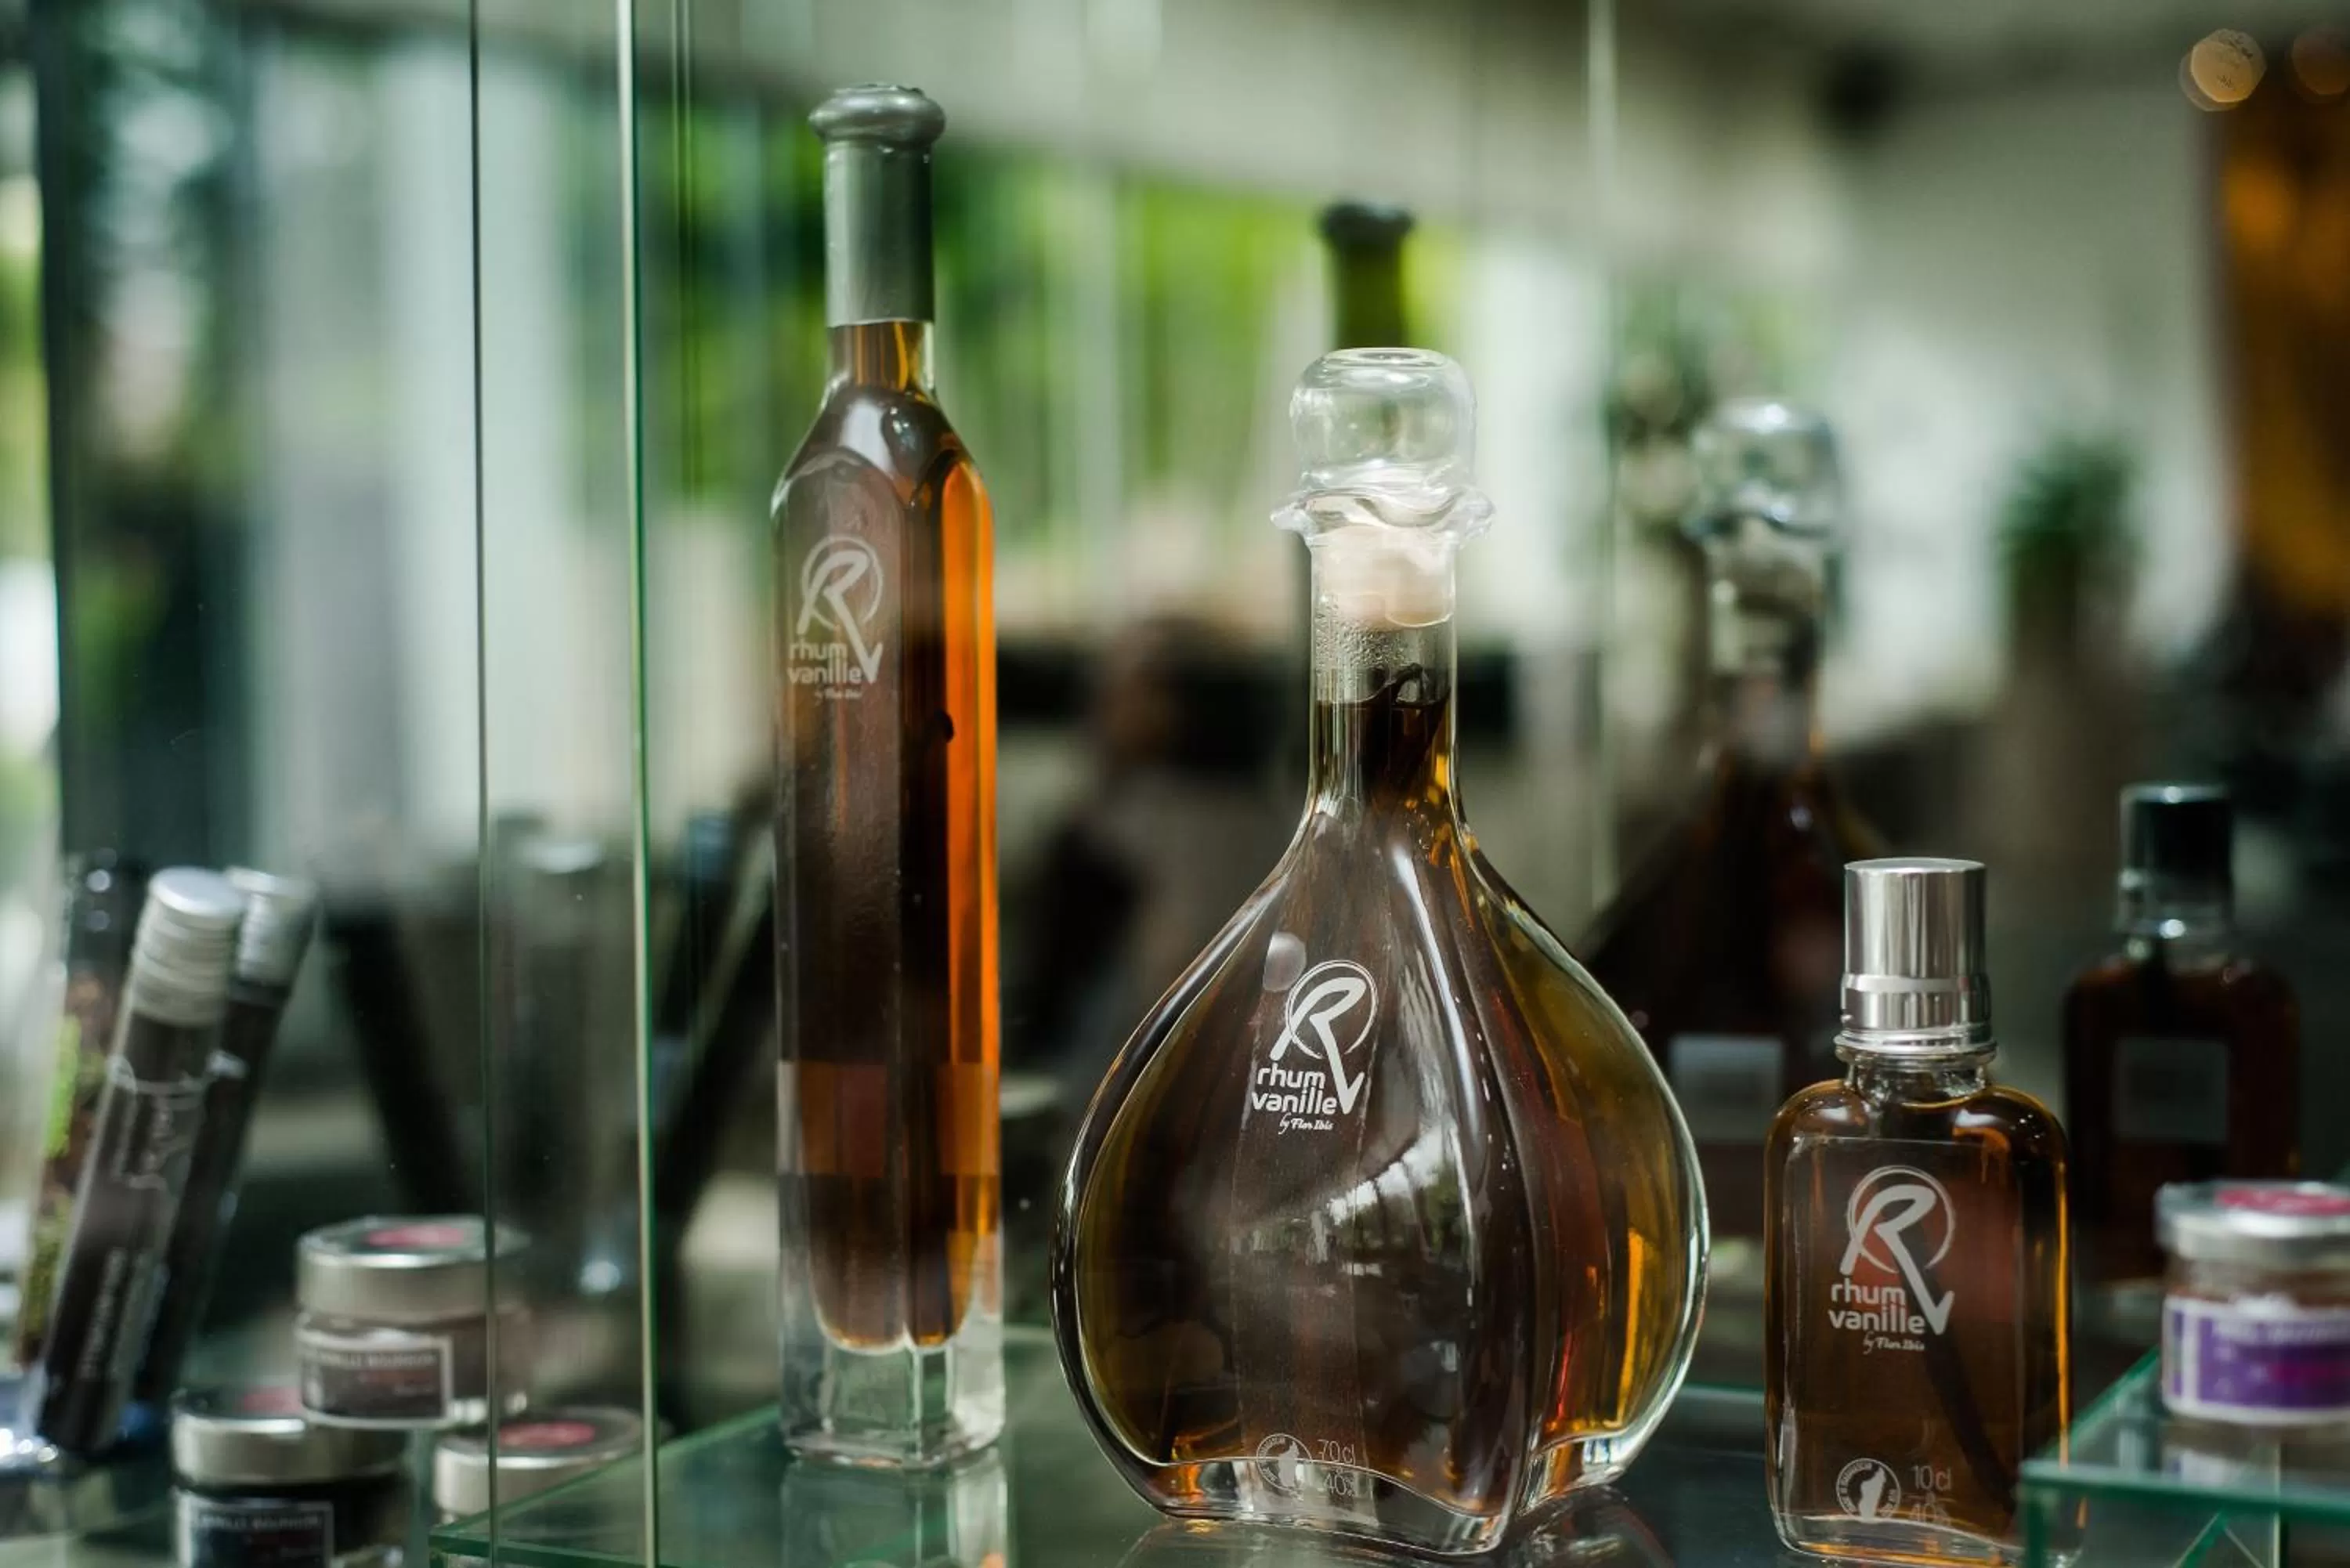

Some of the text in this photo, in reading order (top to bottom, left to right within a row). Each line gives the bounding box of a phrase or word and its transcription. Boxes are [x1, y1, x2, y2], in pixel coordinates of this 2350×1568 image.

[789, 636, 848, 659] rhum
[786, 659, 862, 684] vanille
[1256, 1062, 1326, 1089] rhum
[1252, 1086, 1337, 1115] vanille
[1278, 1112, 1290, 1135] by
[1831, 1277, 1907, 1306] rhum
[1828, 1305, 1925, 1334] vanille
